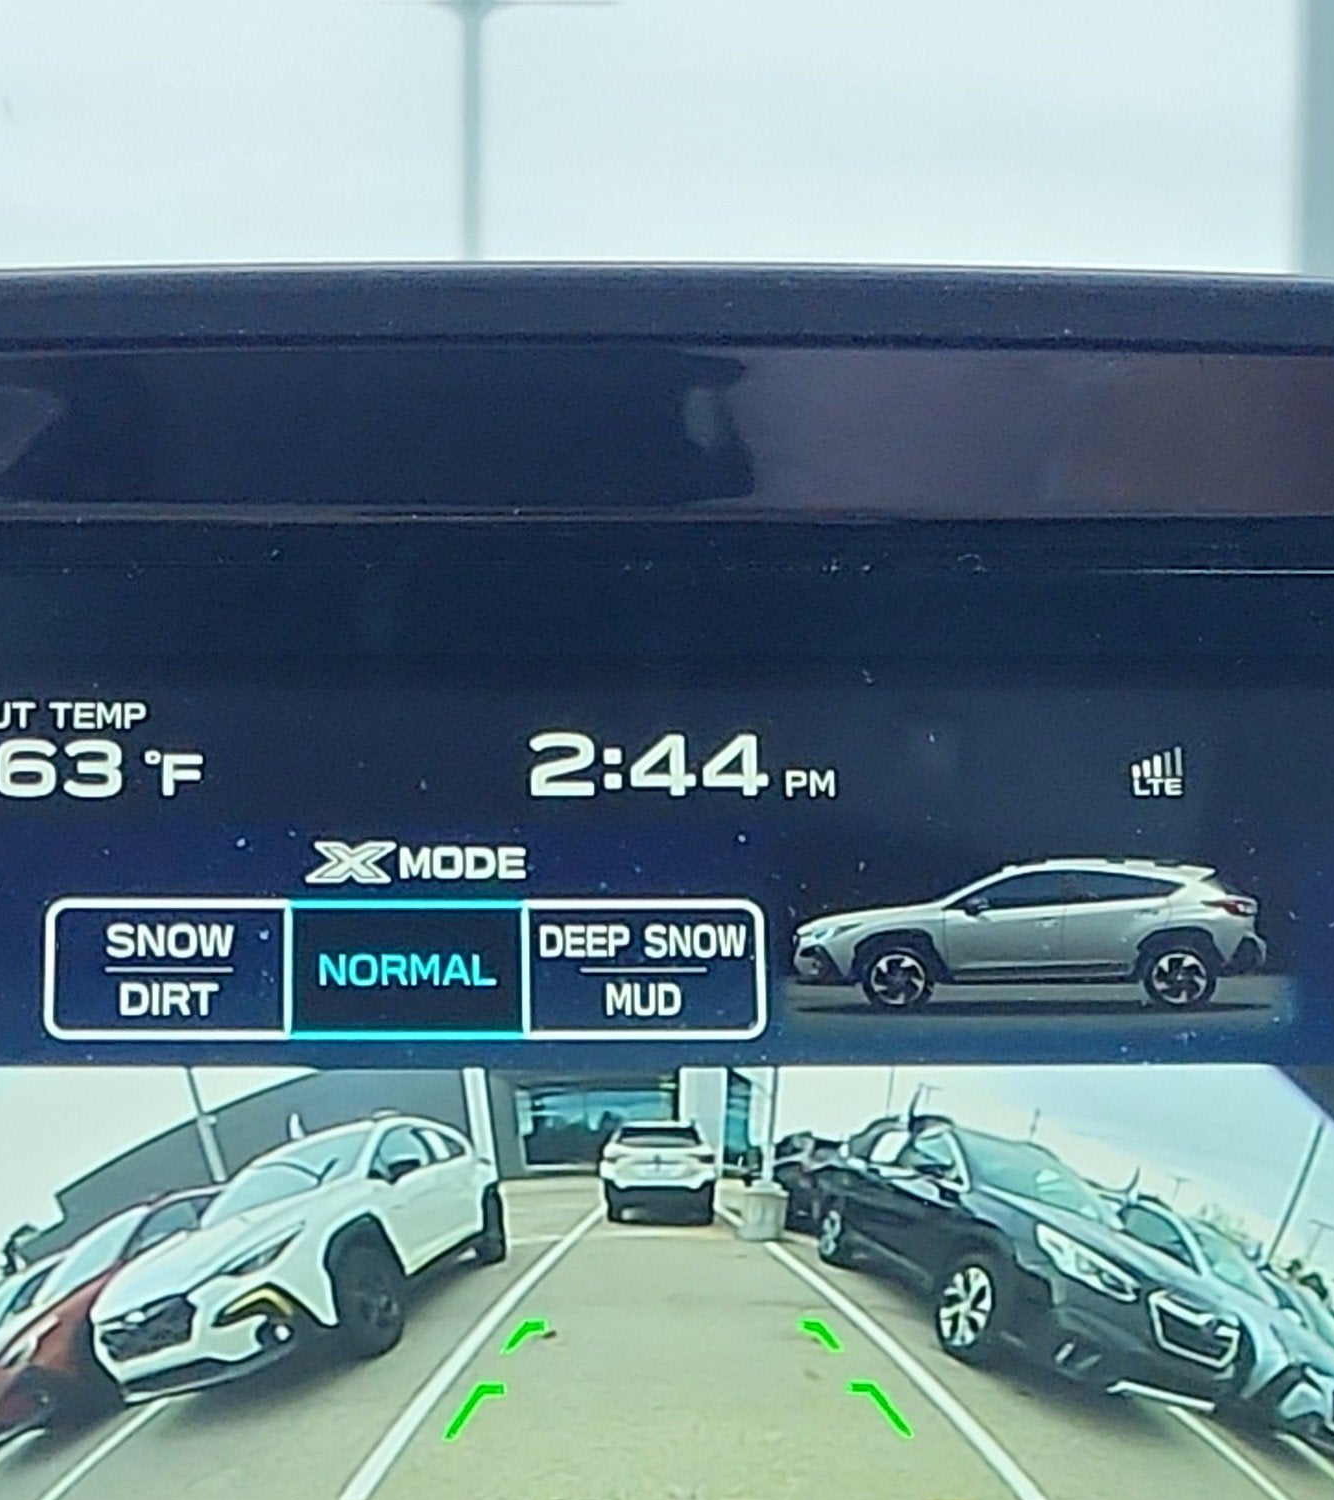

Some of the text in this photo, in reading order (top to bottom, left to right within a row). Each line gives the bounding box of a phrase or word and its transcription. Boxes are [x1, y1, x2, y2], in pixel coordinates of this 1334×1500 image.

[47, 700, 148, 731] TEMP
[528, 731, 837, 799] 2:44 PM
[1131, 776, 1184, 797] LTE
[105, 922, 236, 960] SNOW
[538, 923, 748, 960] DEEP SNOW
[317, 951, 499, 988] NORMAL
[118, 980, 221, 1017] DIRT
[604, 981, 683, 1018] MUD
